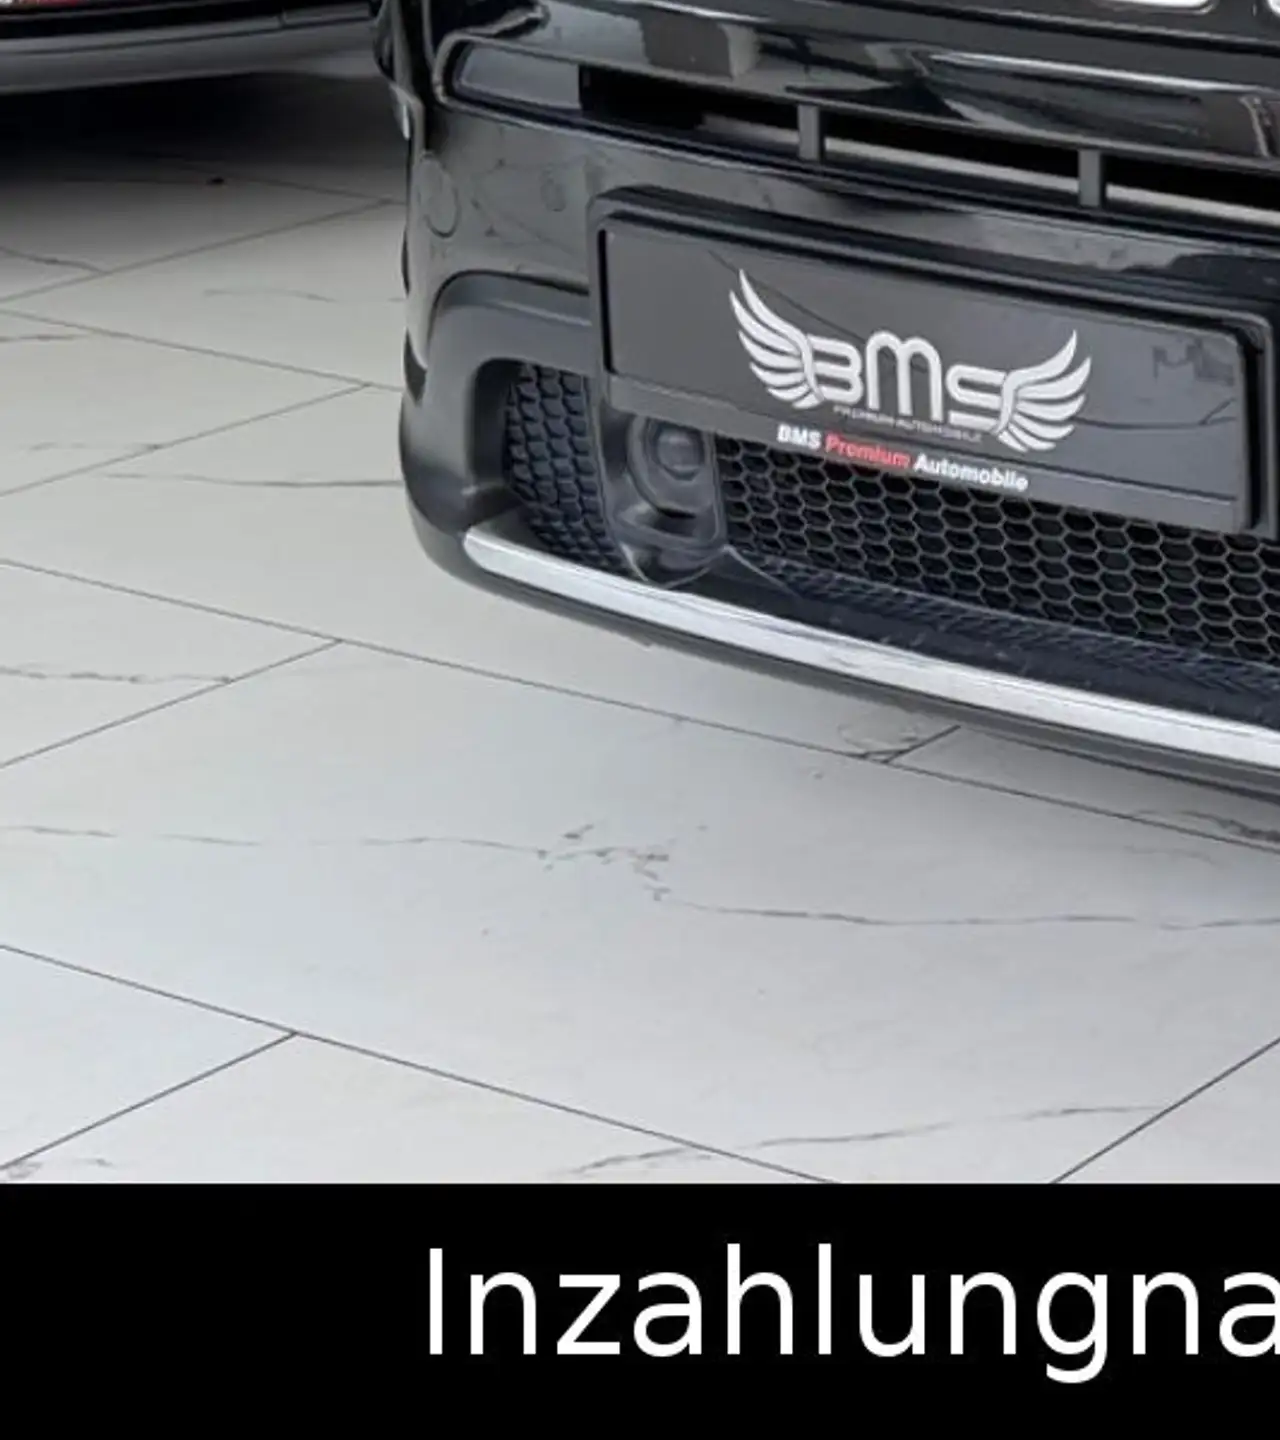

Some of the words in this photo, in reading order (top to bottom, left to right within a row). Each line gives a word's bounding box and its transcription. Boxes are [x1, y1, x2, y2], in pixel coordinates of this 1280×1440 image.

[805, 331, 1006, 433] BMS
[776, 423, 821, 450] BMS
[825, 431, 911, 470] Premium
[912, 451, 1029, 492] Automobile
